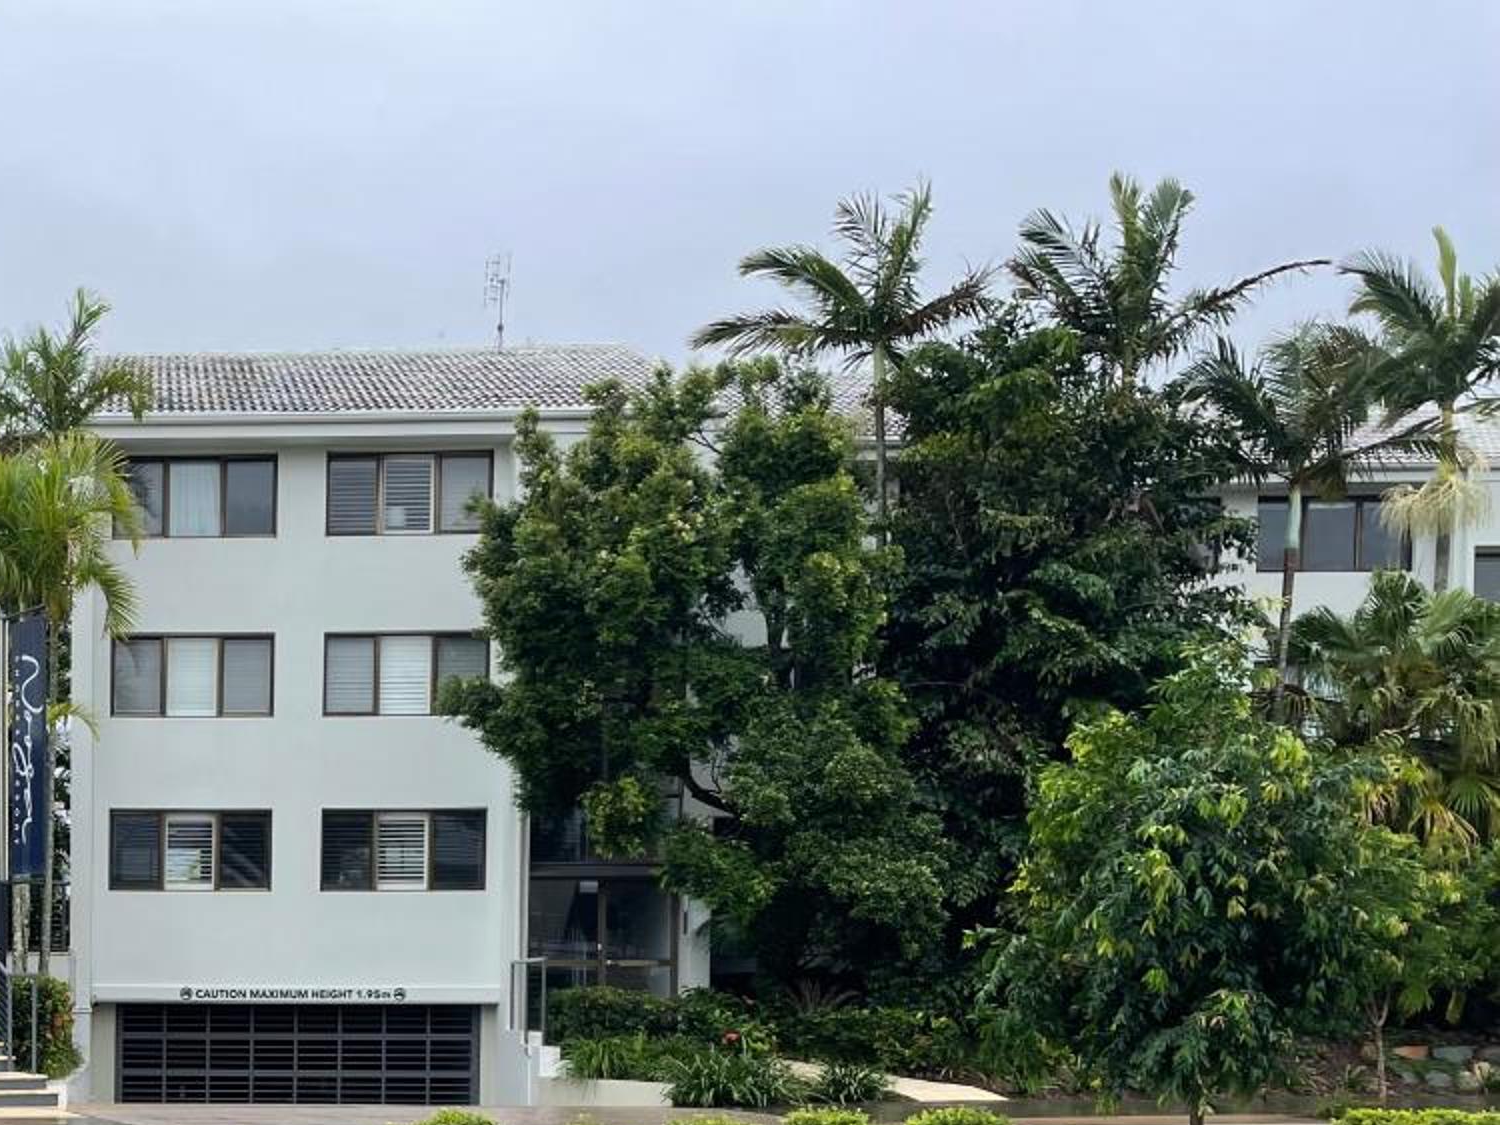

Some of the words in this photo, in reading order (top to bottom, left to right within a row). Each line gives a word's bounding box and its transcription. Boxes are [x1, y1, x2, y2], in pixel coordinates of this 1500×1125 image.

[195, 989, 246, 999] CAUTION
[249, 989, 309, 999] MAXIMUM
[311, 989, 353, 999] HEIGHT
